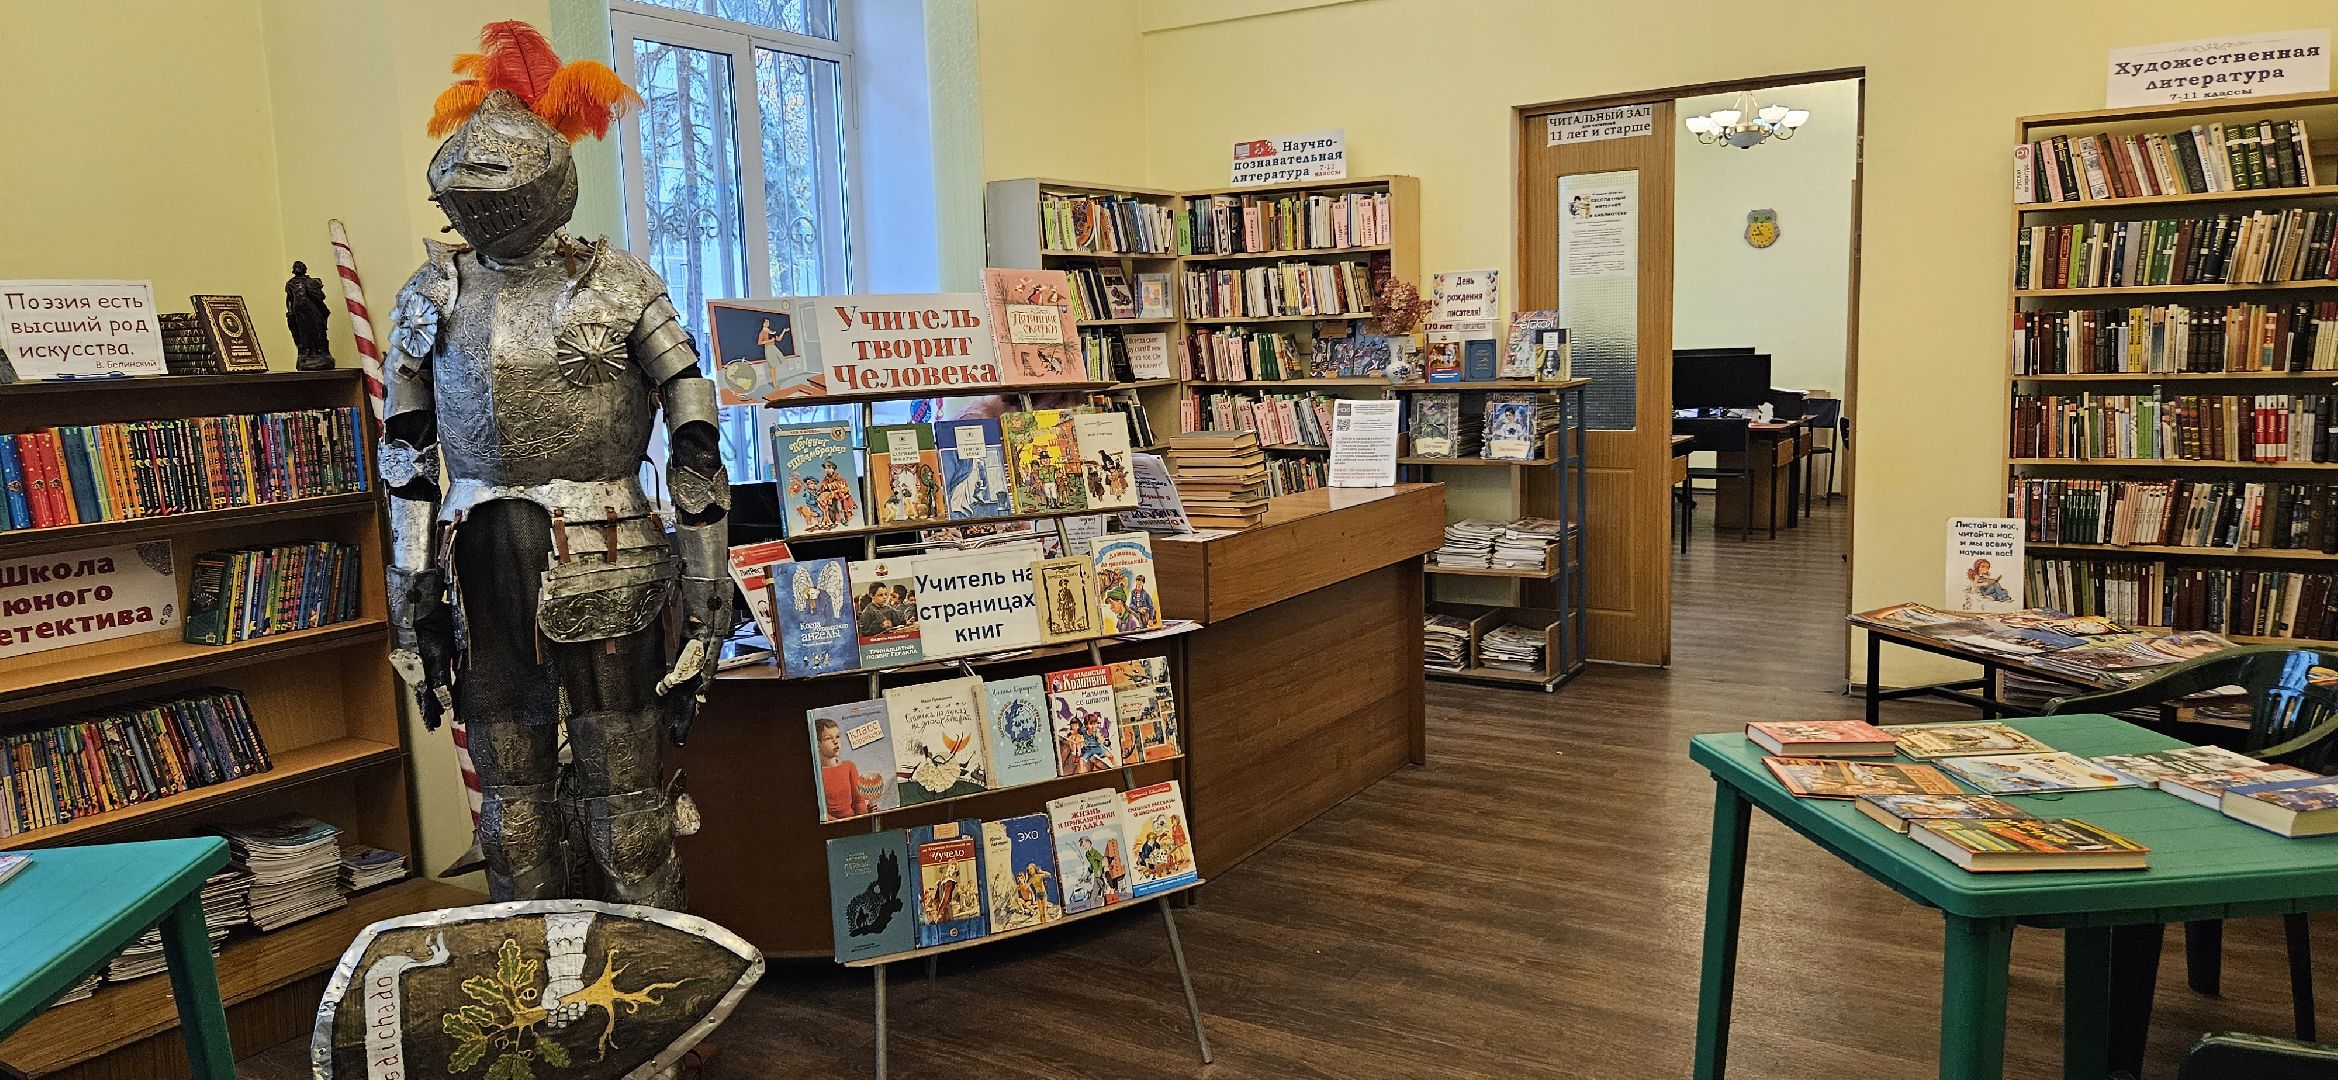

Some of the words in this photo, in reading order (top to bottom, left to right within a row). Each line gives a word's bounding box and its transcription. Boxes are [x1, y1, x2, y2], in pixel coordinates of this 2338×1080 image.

[2114, 46, 2321, 77] Художественная
[2145, 67, 2285, 90] литература
[2170, 92, 2198, 100] 7-11
[2204, 88, 2253, 98] классы
[1549, 109, 1624, 127] ЧИТАЛЬНЫЙ
[1626, 107, 1651, 119] ЗАЛ
[1549, 131, 1562, 141] 11
[1566, 130, 1588, 140] лет
[1592, 129, 1599, 137] и
[1604, 123, 1651, 137] старше
[1282, 139, 1337, 153] Научно-
[1234, 151, 1343, 170] познавательная
[1232, 168, 1309, 183] литература
[1456, 276, 1475, 287] День
[4, 292, 91, 310] Поэзия
[98, 297, 143, 309] есть
[1447, 293, 1483, 305] рождения
[834, 305, 980, 332] Учитель
[1447, 307, 1481, 318] писателя!
[11, 315, 101, 334] высший
[109, 319, 149, 336] род
[1424, 323, 1438, 331] 170
[20, 343, 134, 361] искусства.
[851, 336, 972, 366] творит
[97, 361, 104, 369] В.
[107, 360, 157, 368] Белинский
[833, 362, 998, 391] Человека
[1955, 520, 1998, 529] Листайте
[2001, 523, 2019, 531] нас,
[1958, 530, 1994, 538] читайте
[1997, 532, 2015, 540] нас,
[1985, 541, 2013, 549] всему
[1960, 549, 1993, 557] научим
[1995, 549, 2013, 557] вас!
[0, 556, 115, 588] Школа
[914, 570, 1006, 594] Учитель
[1011, 567, 1033, 581] на
[3, 584, 114, 617] юного
[919, 591, 1036, 623] страницах
[800, 621, 821, 632] Когда
[955, 623, 1004, 643] книг
[801, 629, 841, 642] ангелы
[868, 644, 914, 655] ТРИНАДЦАТЫЙ
[1073, 668, 1106, 679] ВЛАДИСЛАВ
[1062, 673, 1108, 691] Крапивин
[1081, 690, 1110, 699] Мальчик
[1085, 695, 1110, 705] шпагой
[1071, 806, 1101, 819] ЖИЗНЬ
[1063, 811, 1116, 828] ПРИКЛЮЧЕНИЯ
[1071, 820, 1104, 833] ЧУДАКА
[1017, 830, 1038, 842] ЭХО
[930, 850, 965, 862] Чучело
